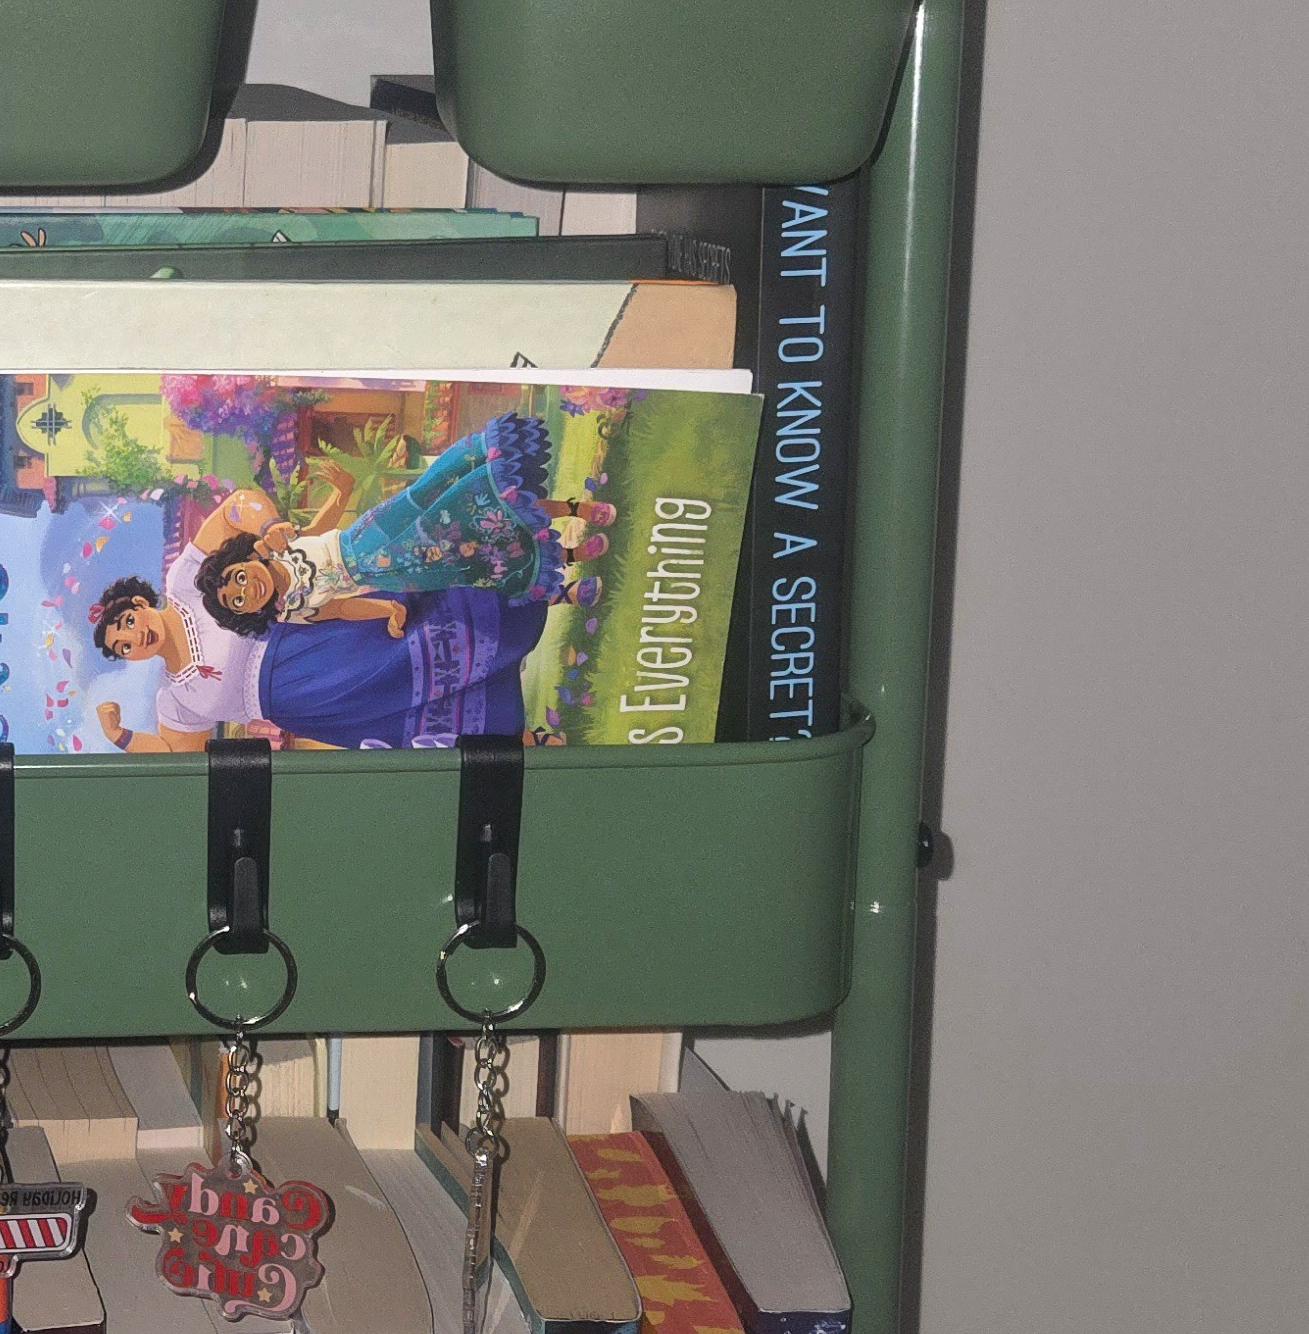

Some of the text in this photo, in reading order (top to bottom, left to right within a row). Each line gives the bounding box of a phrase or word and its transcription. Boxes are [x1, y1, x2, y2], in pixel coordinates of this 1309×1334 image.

[778, 305, 826, 362] TO
[773, 381, 822, 510] KNOW
[772, 532, 817, 558] A
[620, 496, 712, 713] Everything
